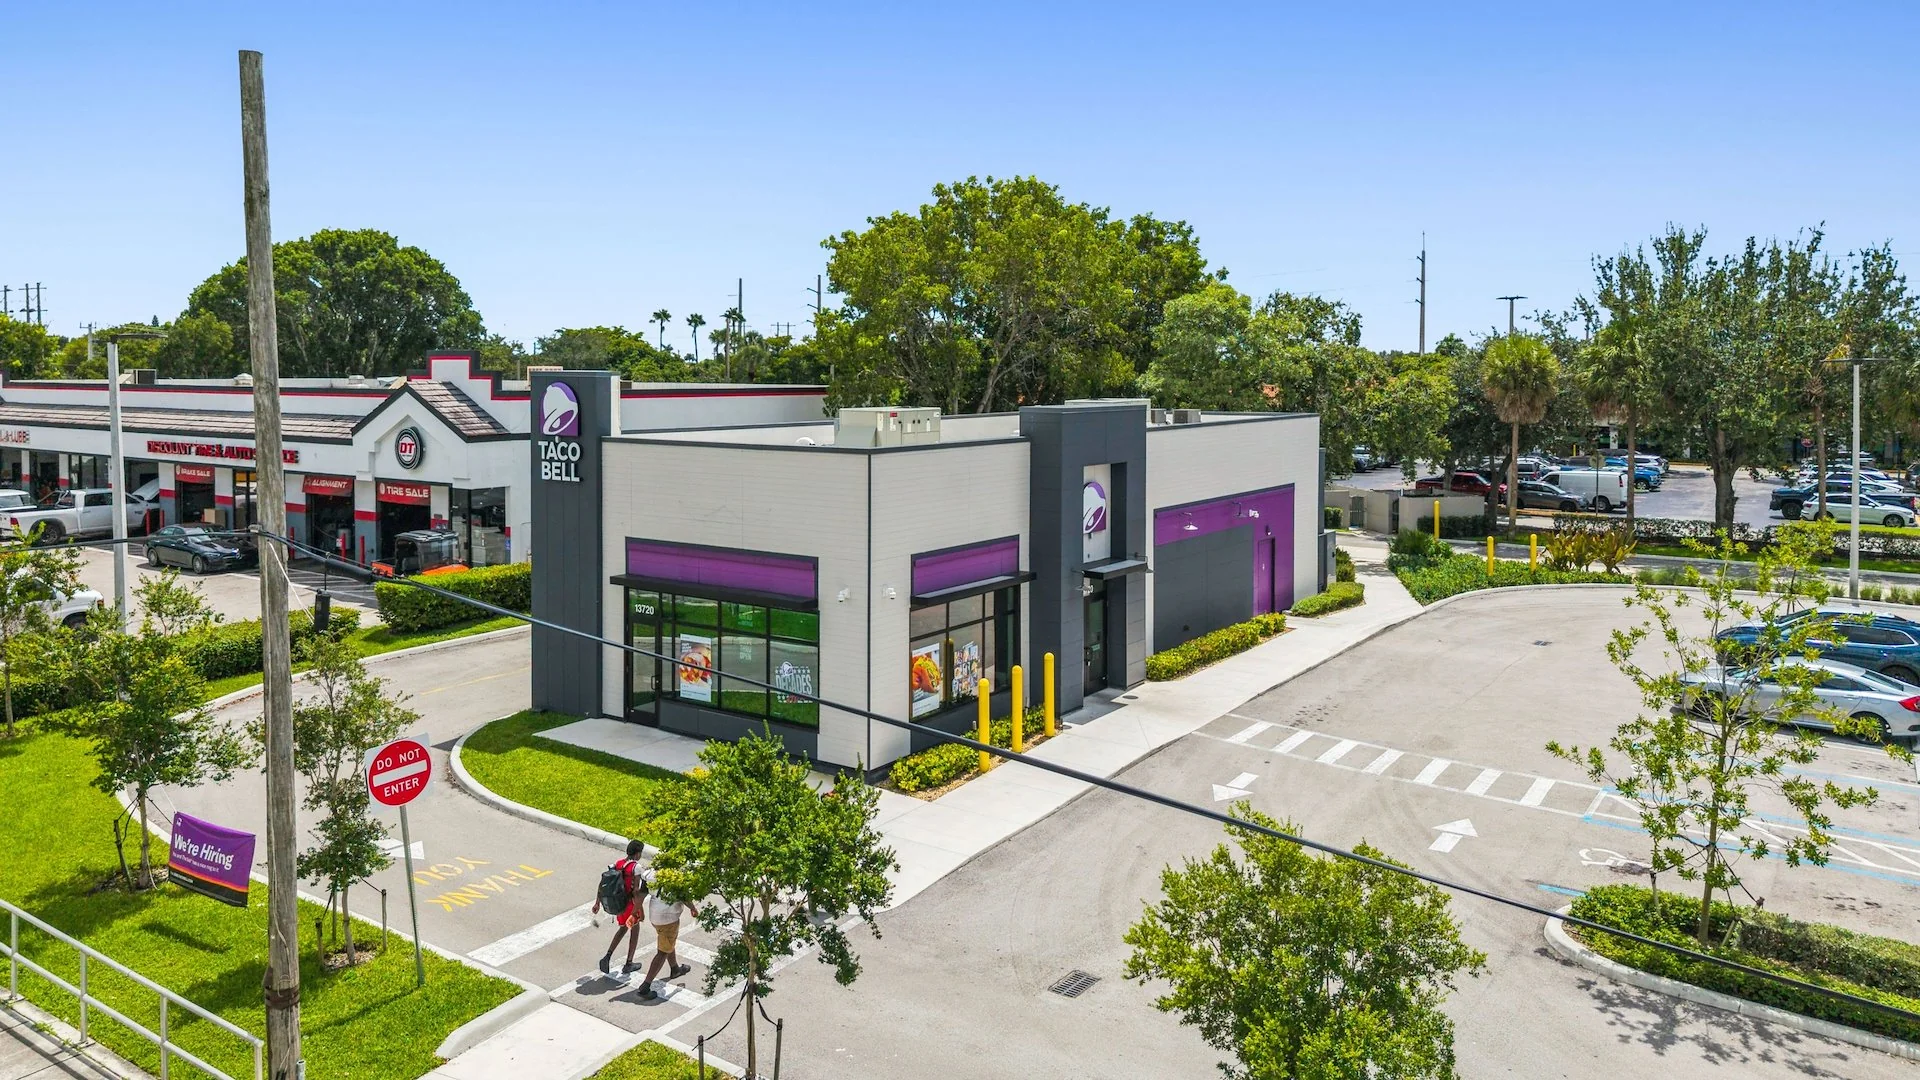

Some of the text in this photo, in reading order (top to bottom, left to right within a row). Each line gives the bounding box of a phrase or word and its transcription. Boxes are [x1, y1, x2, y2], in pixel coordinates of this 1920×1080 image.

[147, 441, 192, 455] DISCOUNT
[400, 442, 415, 454] DT
[538, 441, 580, 461] TACO
[181, 468, 196, 476] BRAKE
[542, 461, 580, 482] BELL
[311, 479, 348, 489] ALIGNMENT
[386, 485, 429, 498] TIRE SALE
[635, 604, 655, 615] 13720
[775, 674, 813, 695] DECADES
[376, 748, 420, 771] DO NOT
[384, 777, 420, 798] ENTER
[174, 833, 200, 857] We're
[199, 843, 234, 871] Hiring
[411, 856, 492, 886] YOU
[424, 864, 554, 913] THANK
